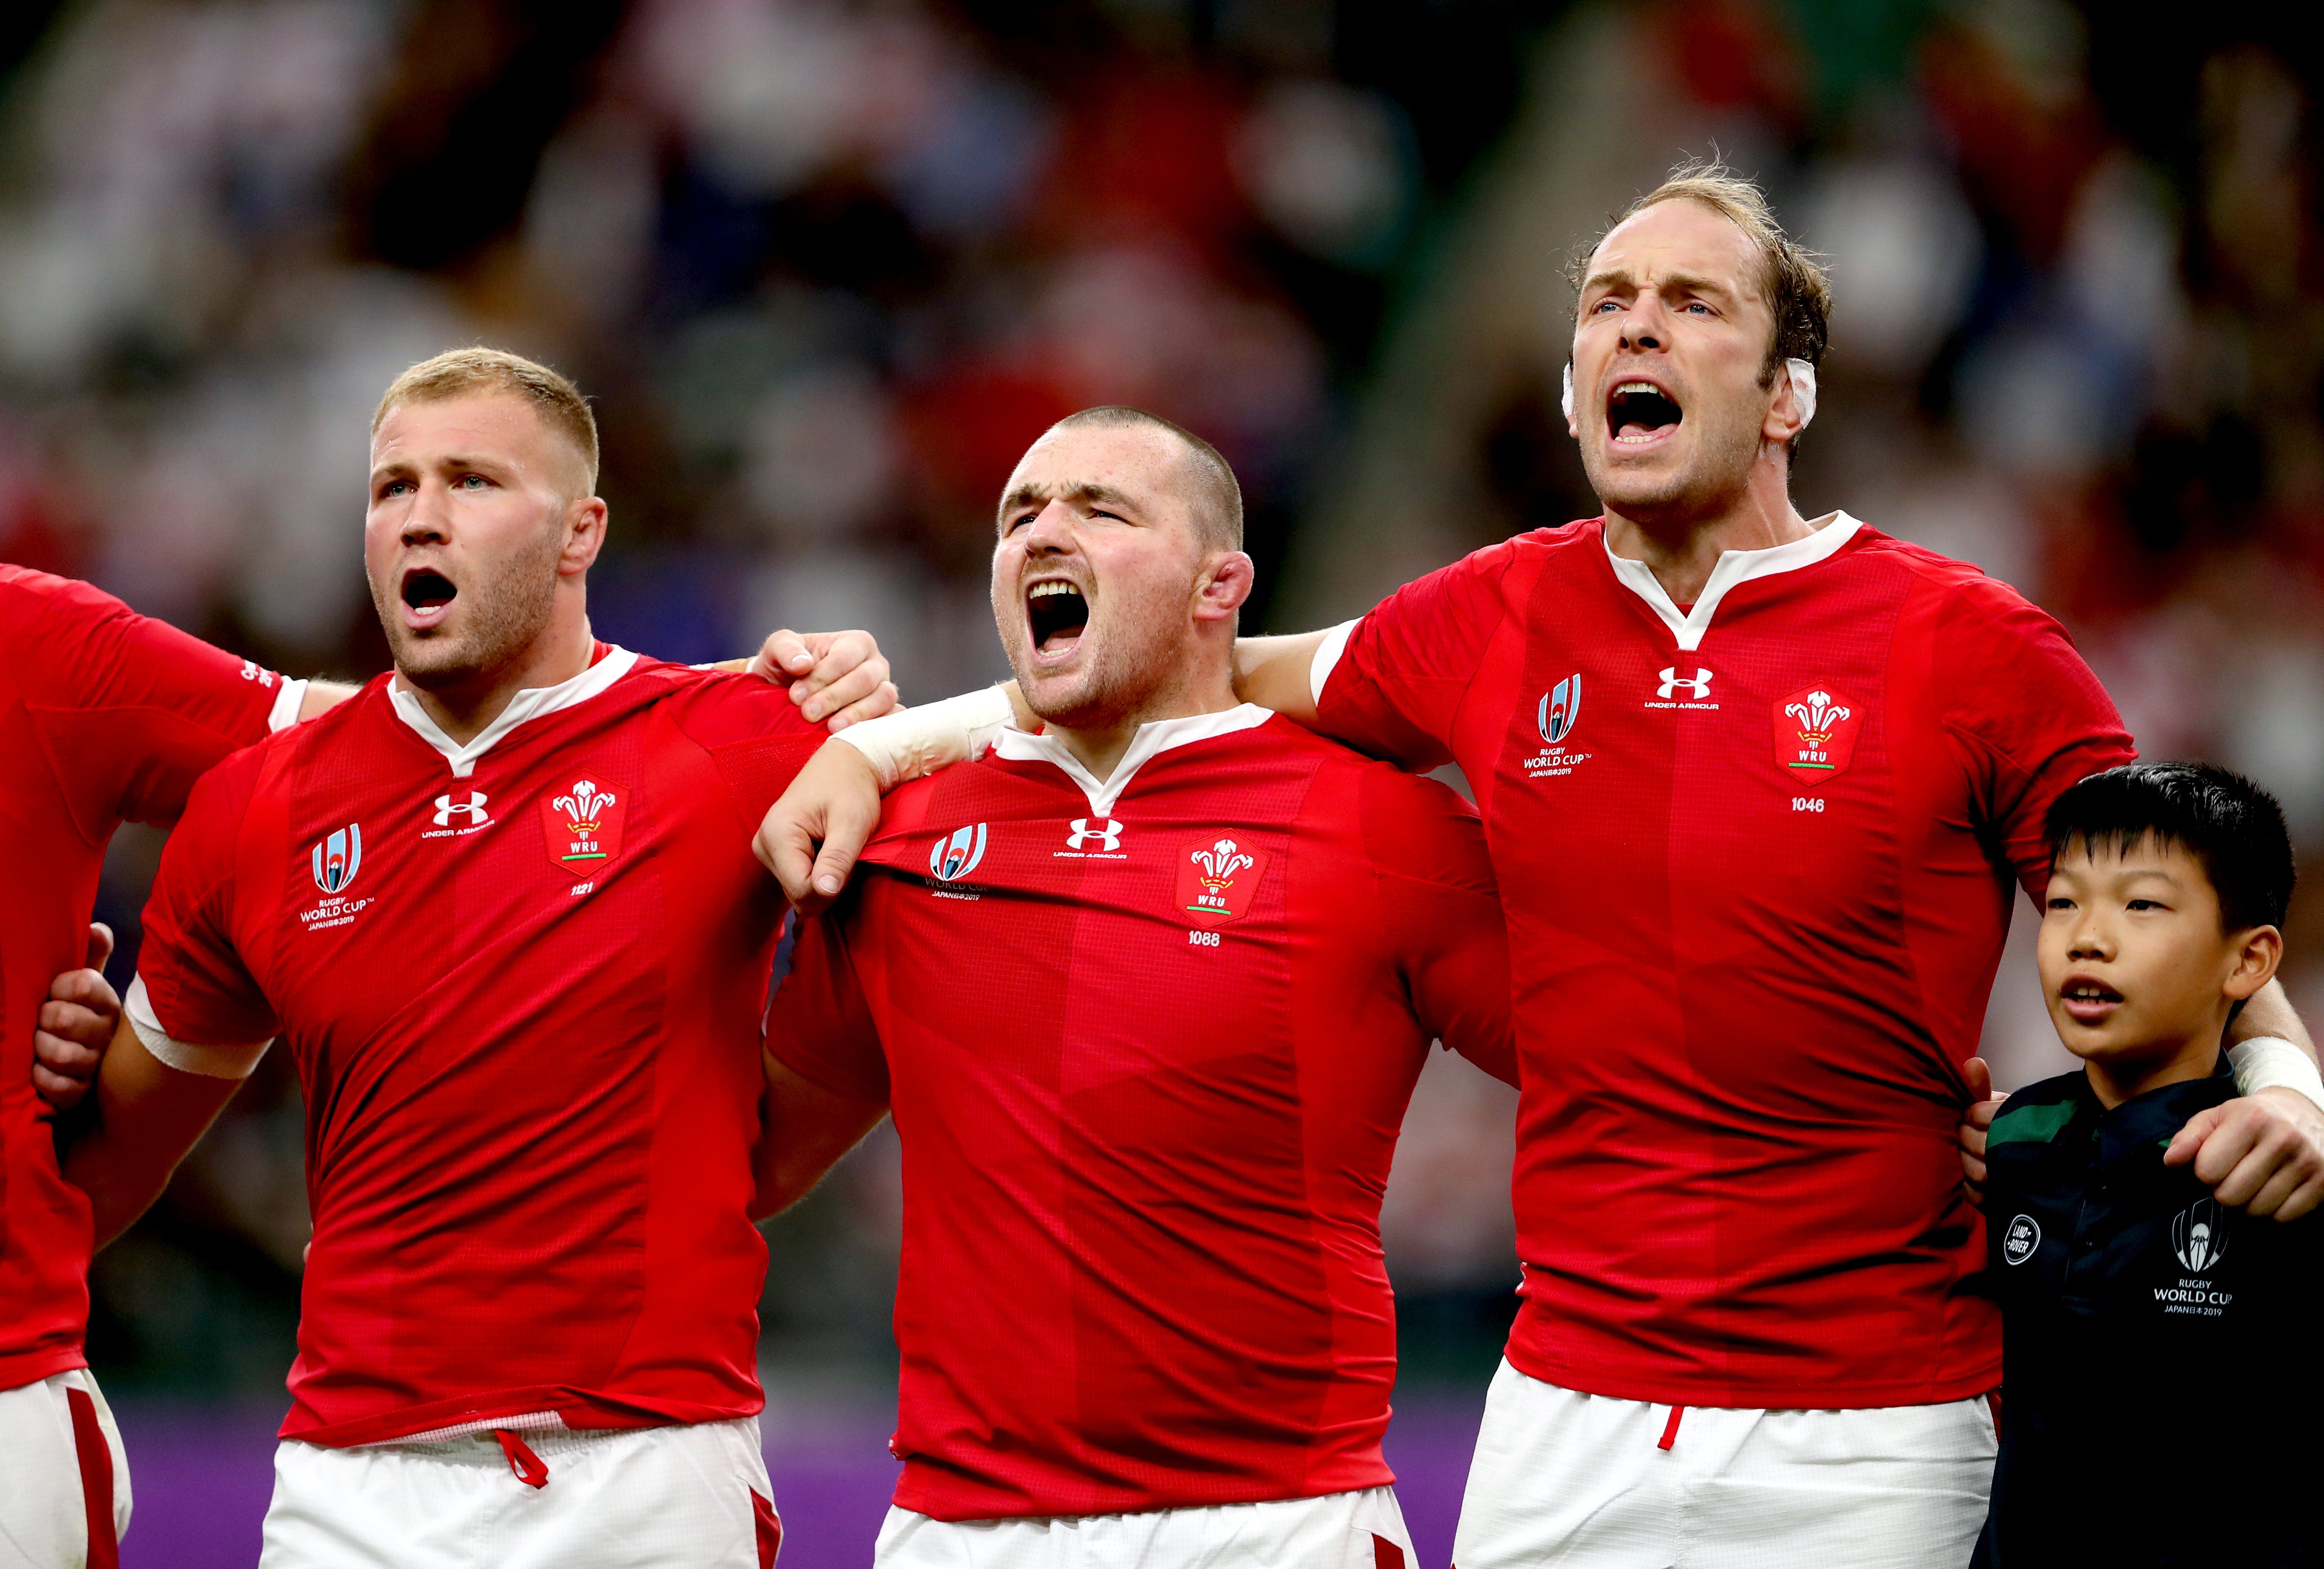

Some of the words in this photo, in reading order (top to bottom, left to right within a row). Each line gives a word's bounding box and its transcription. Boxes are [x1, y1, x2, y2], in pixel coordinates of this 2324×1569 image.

[1540, 747, 1566, 756] RUGBY
[1799, 750, 1827, 762] WRU
[1524, 756, 1560, 768] WORLD
[1792, 797, 1825, 813] 1046
[422, 830, 454, 839] UNDER
[570, 841, 598, 853] WRU
[571, 882, 593, 896] 1121
[319, 896, 346, 908] RUGBY
[1198, 894, 1226, 907] WRU
[300, 906, 340, 922] WORLD
[1189, 930, 1220, 947] 1088
[2008, 1239, 2029, 1254] ROVER
[2179, 1278, 2212, 1290] RUGBY
[2154, 1288, 2206, 1303] WORLD
[2209, 1292, 2232, 1305] CUP
